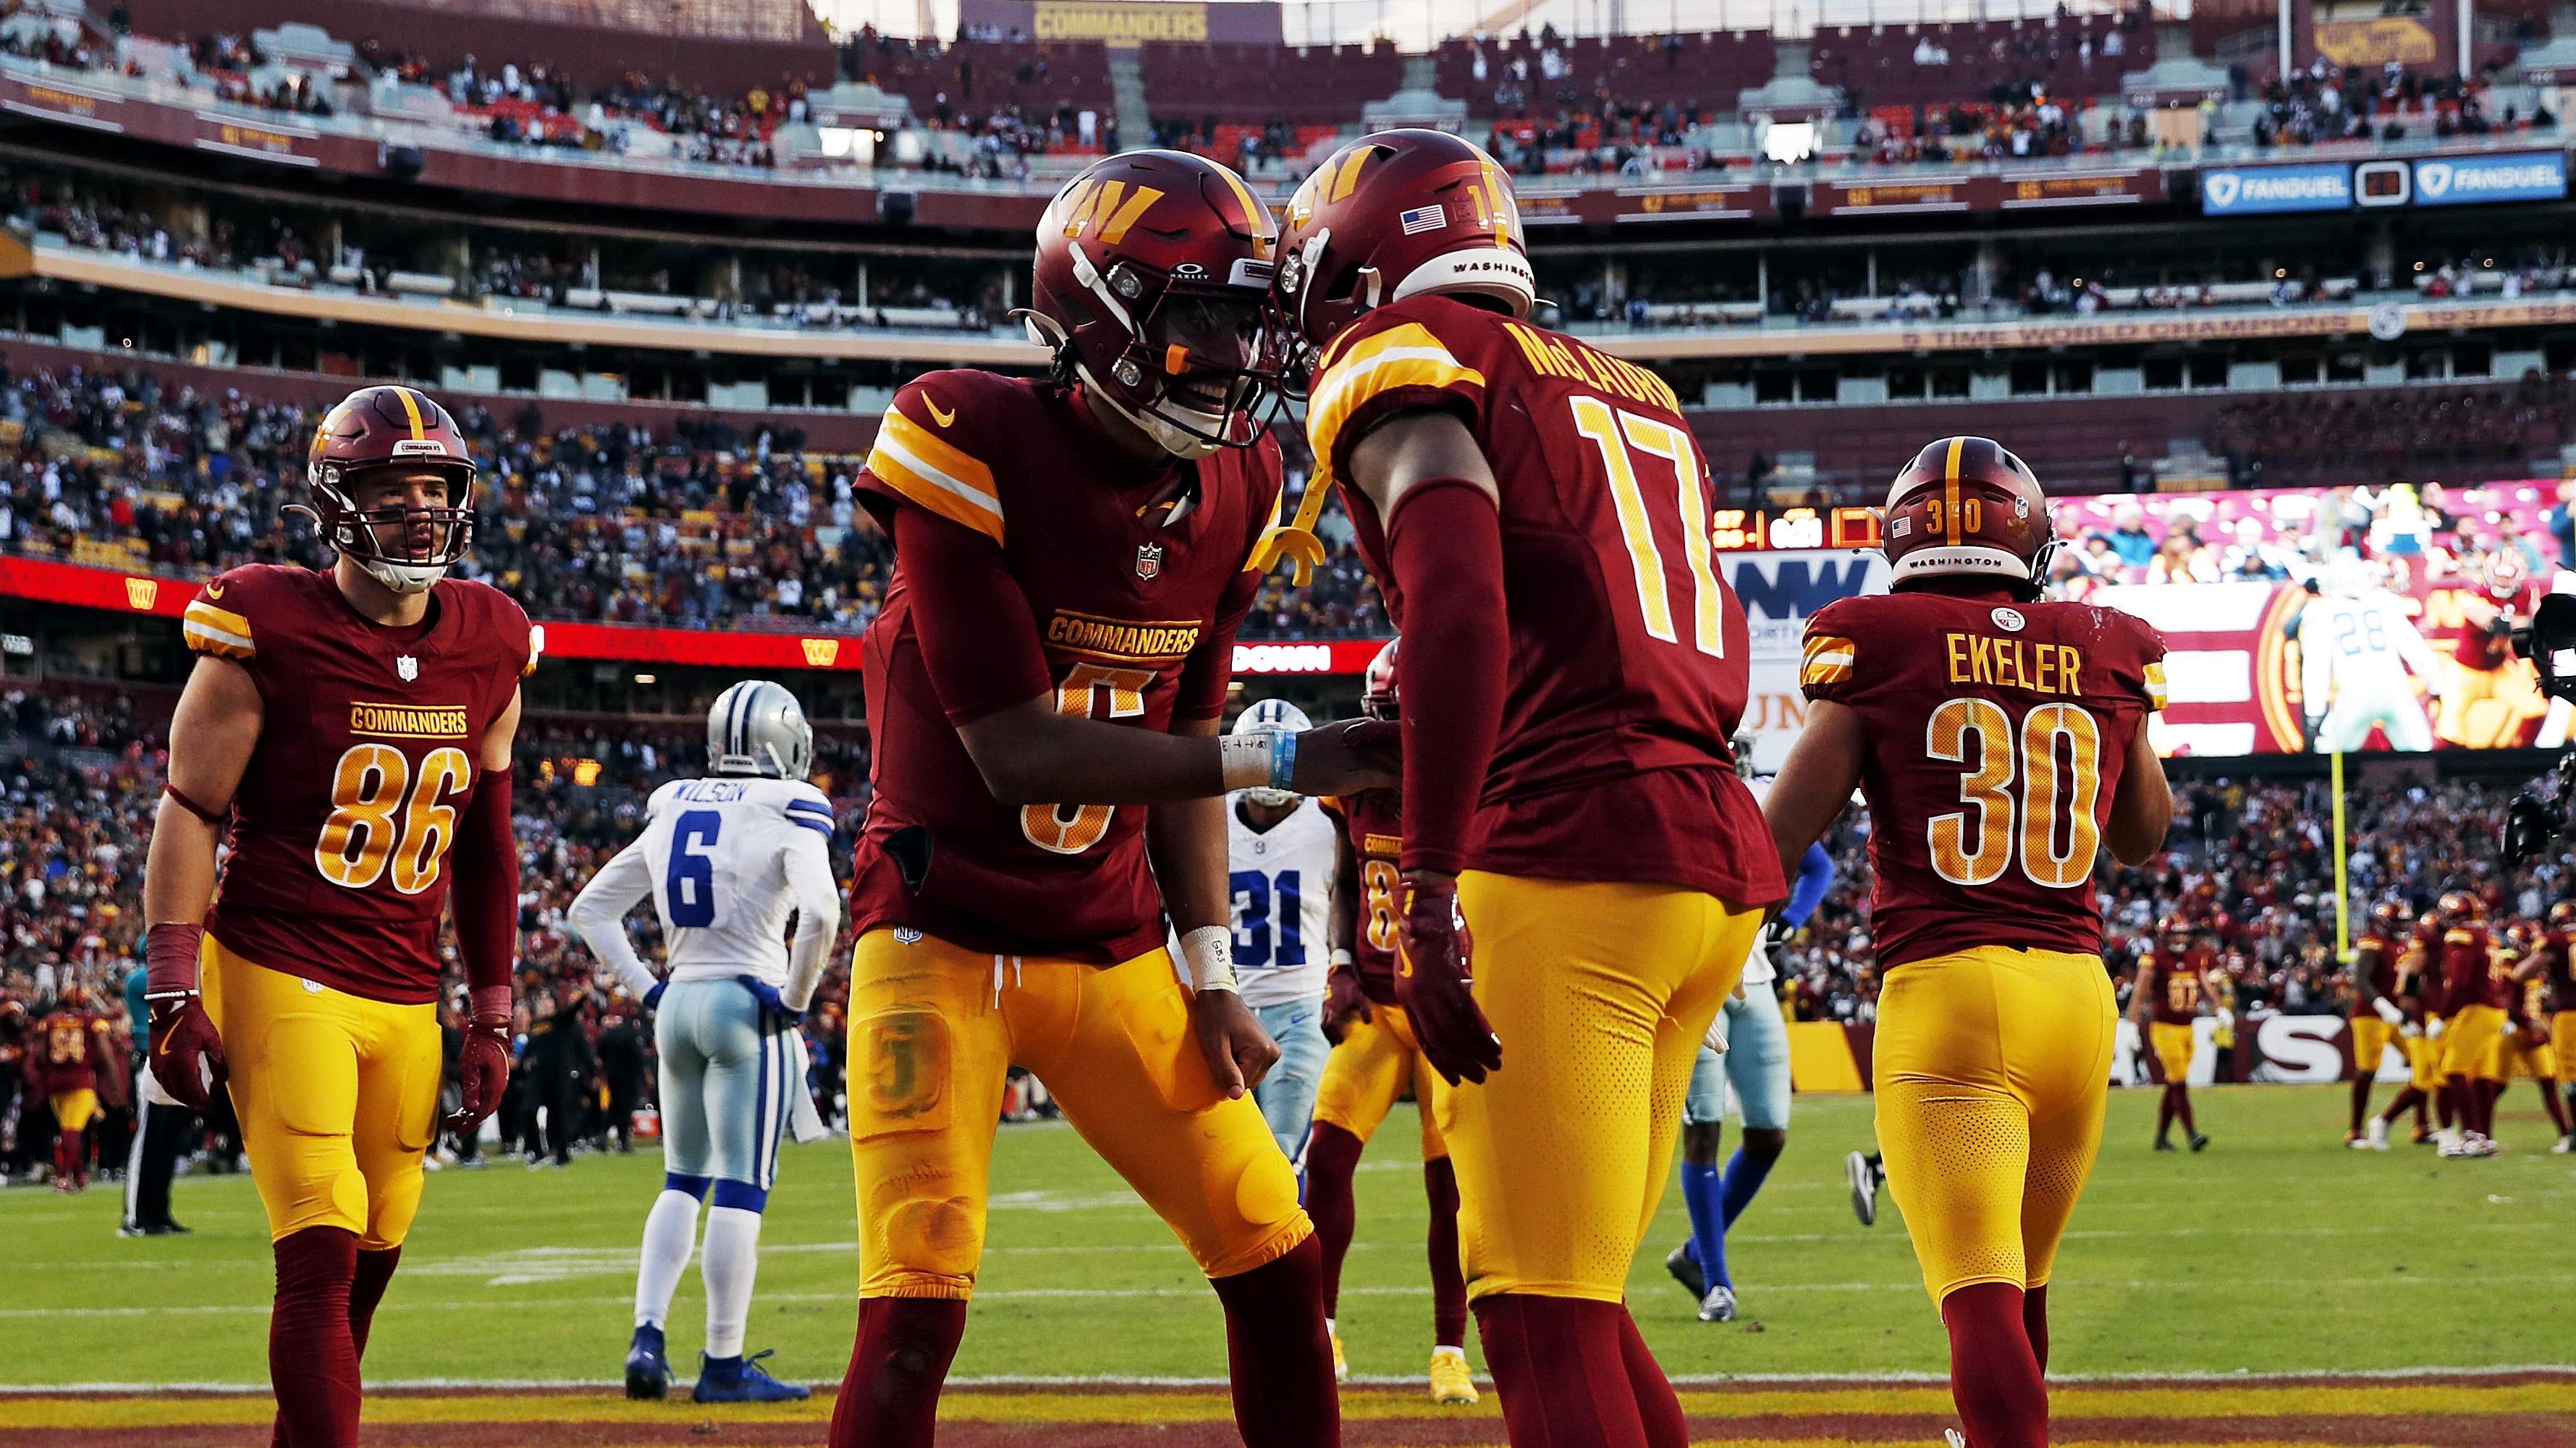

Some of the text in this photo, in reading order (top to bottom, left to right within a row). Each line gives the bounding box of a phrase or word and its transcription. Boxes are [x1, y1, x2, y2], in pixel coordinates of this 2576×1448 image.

[2242, 175, 2348, 200] FANDUEL
[2453, 164, 2562, 191] FANDUEL
[1935, 330, 2006, 347] TIME
[2019, 324, 2140, 344] WORLD
[1568, 395, 1725, 660] 17
[1925, 498, 1982, 535] 30
[1909, 557, 2002, 569] WASHINGTON
[1048, 616, 1199, 654] COMMANDERS
[1946, 633, 2082, 697] EKELER
[351, 706, 468, 734] COMMANDERS
[1926, 698, 2100, 889] 30
[314, 743, 471, 895] 86
[667, 810, 722, 928] 6
[1230, 869, 1306, 967] 31
